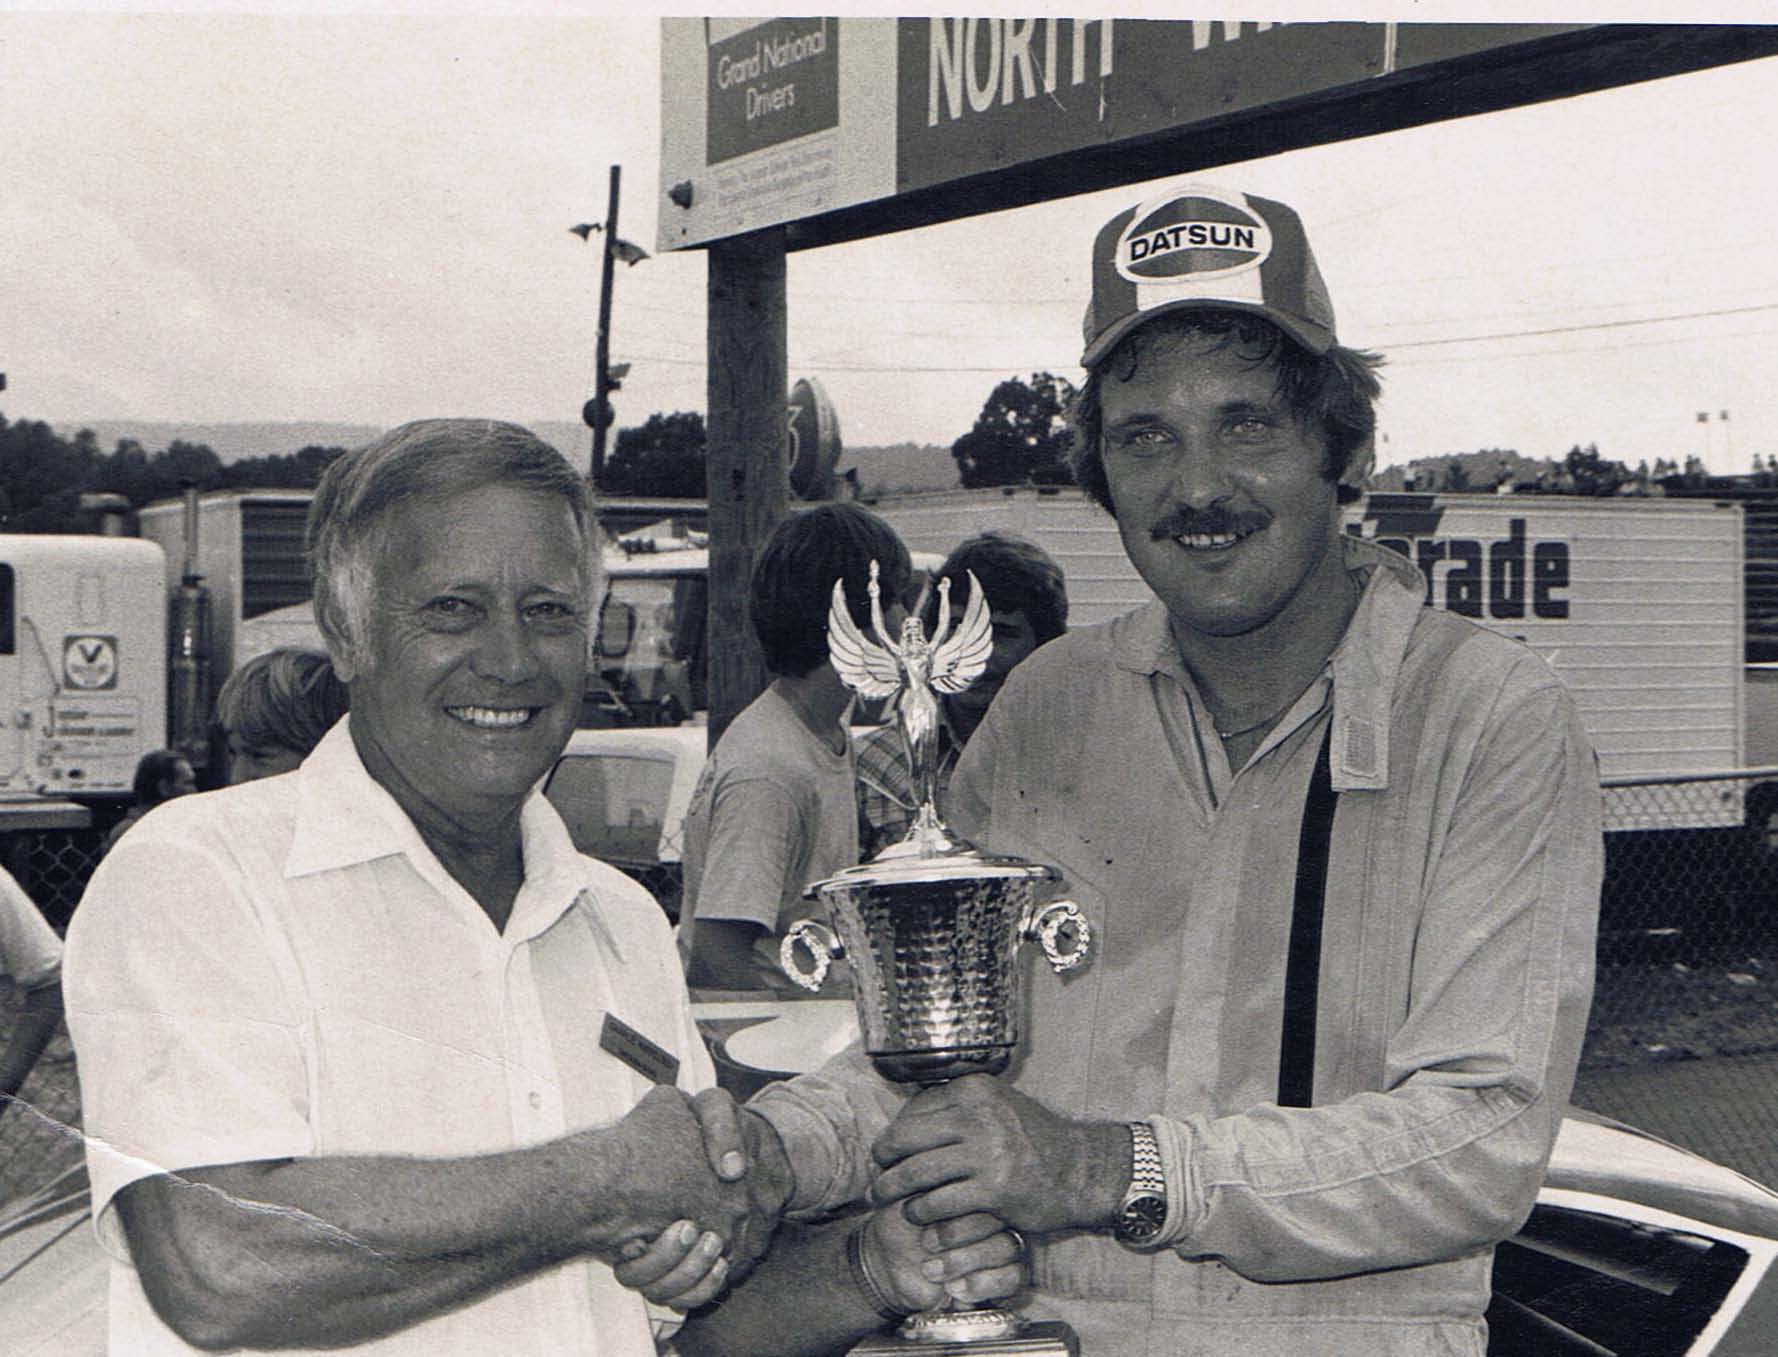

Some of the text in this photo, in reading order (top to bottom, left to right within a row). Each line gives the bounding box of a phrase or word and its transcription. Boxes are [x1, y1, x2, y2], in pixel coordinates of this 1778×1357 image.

[718, 18, 826, 89] Grand National
[746, 83, 795, 120] Drivers
[1130, 224, 1255, 262] DATSUN
